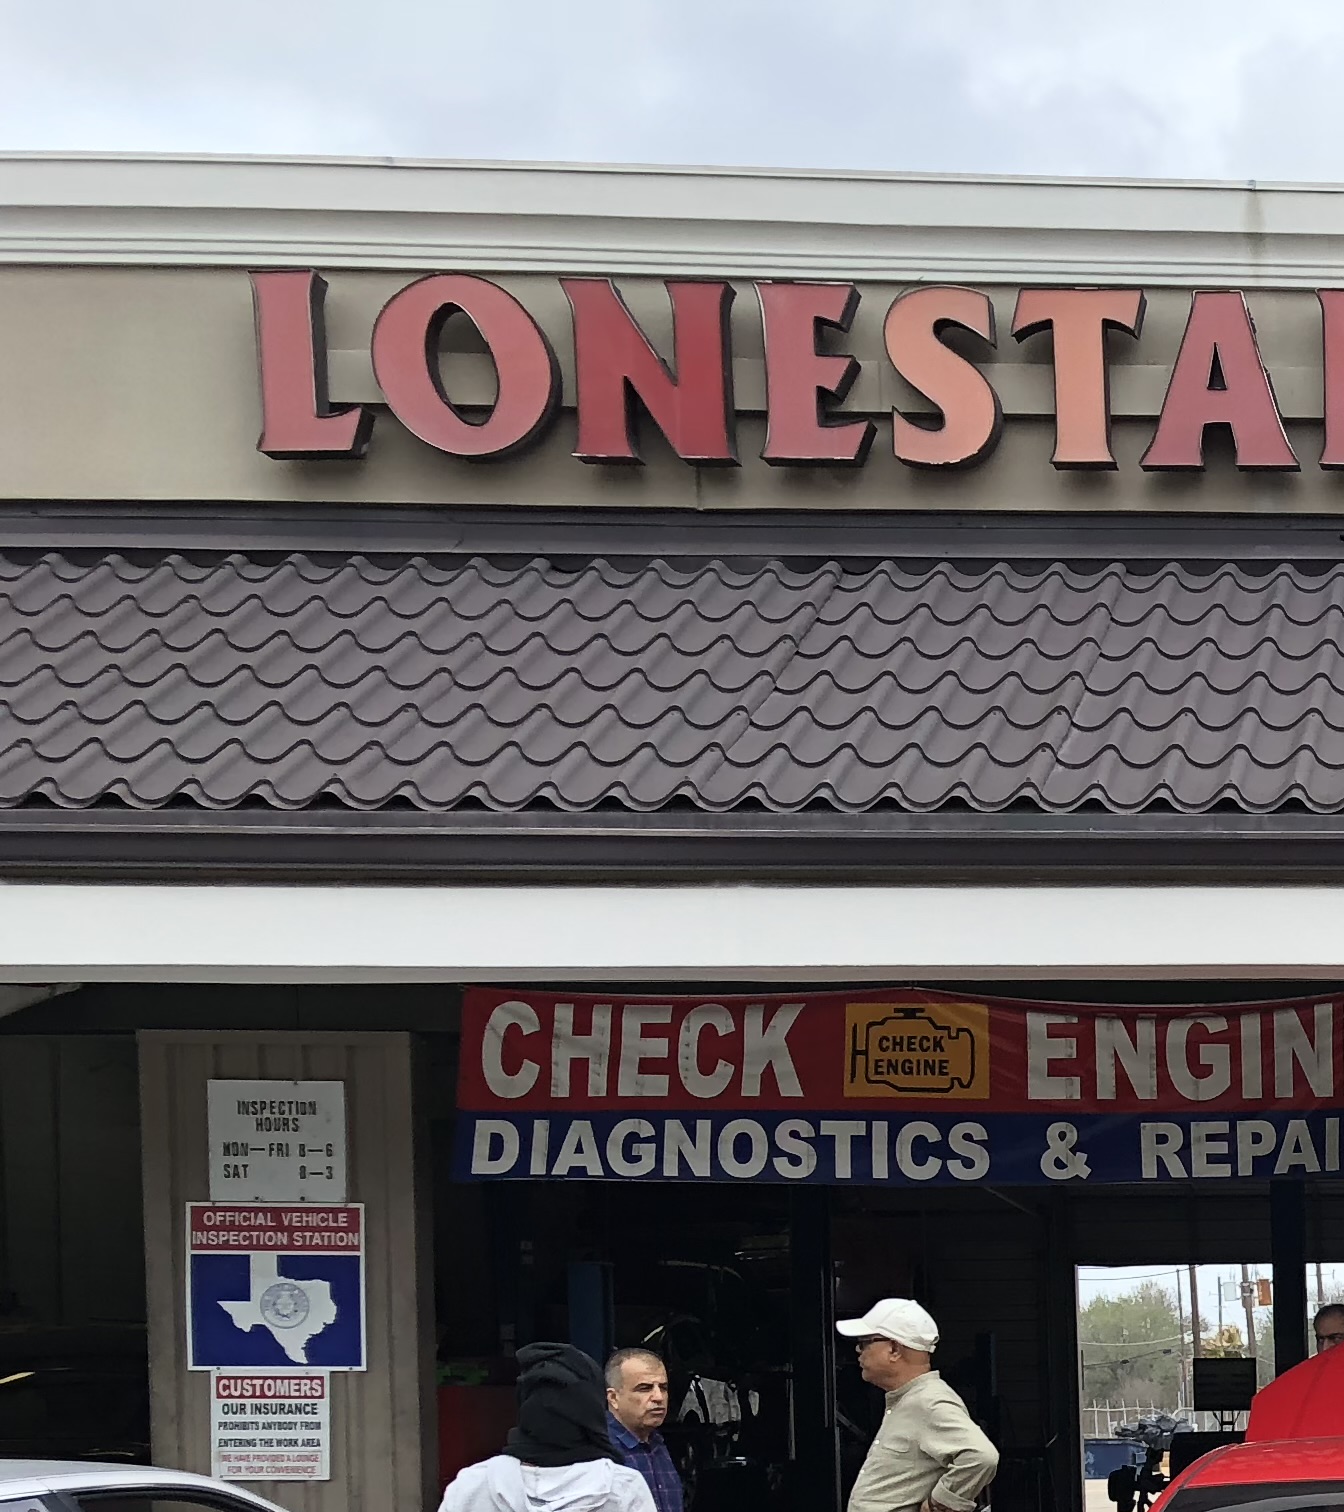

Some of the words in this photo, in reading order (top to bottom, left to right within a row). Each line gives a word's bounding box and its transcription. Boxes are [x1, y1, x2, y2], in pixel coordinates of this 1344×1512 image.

[481, 1000, 806, 1099] CHECK
[878, 1035, 945, 1053] CHECK
[873, 1059, 950, 1076] ENGINE
[236, 1100, 317, 1116] INSPECTION
[255, 1117, 300, 1132] HOURS
[470, 1118, 991, 1181] DIAGNOSTICS
[1040, 1121, 1093, 1181] &
[223, 1163, 249, 1179] SAT
[203, 1211, 276, 1227] OFFICIAL
[282, 1212, 349, 1227] VEHICLE
[192, 1230, 288, 1246] INSPECTION
[292, 1231, 360, 1246] STATION
[218, 1378, 322, 1397] CUSTOMERS
[221, 1402, 247, 1416] OUR
[250, 1402, 319, 1416] INSURANCE
[217, 1421, 260, 1431] PROHIBITS
[261, 1421, 298, 1431] ANYBODY
[300, 1421, 322, 1431] FROM
[218, 1438, 257, 1448] ENTERING
[259, 1438, 274, 1448] THE
[275, 1438, 299, 1448] WORK
[300, 1438, 321, 1448] AREA
